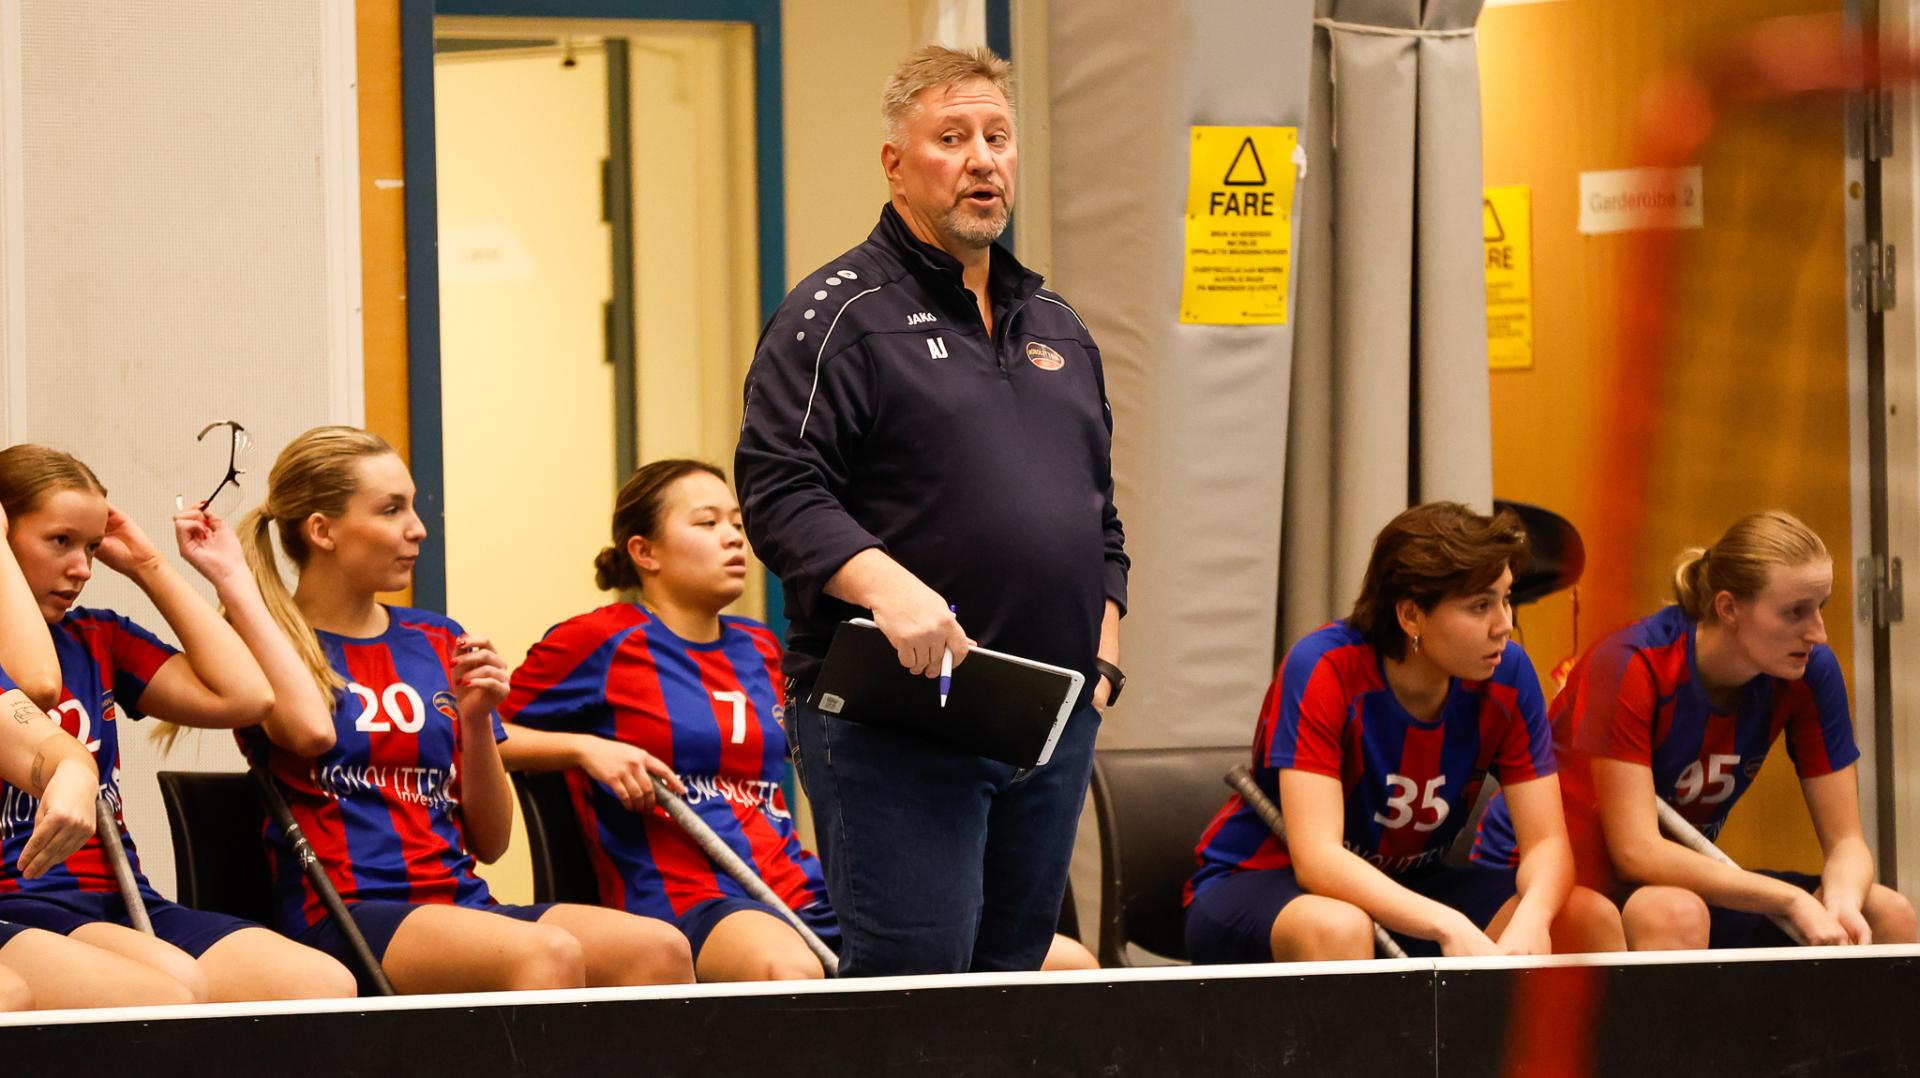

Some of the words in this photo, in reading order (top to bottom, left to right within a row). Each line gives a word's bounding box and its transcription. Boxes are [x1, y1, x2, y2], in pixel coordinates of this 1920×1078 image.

[1209, 191, 1275, 216] FARE
[1683, 185, 1694, 208] 2
[907, 312, 937, 326] JAKO
[926, 336, 949, 360] AJ
[347, 682, 426, 733] 20
[712, 690, 747, 744] 7
[1674, 753, 1741, 806] 95
[1374, 774, 1450, 832] 35
